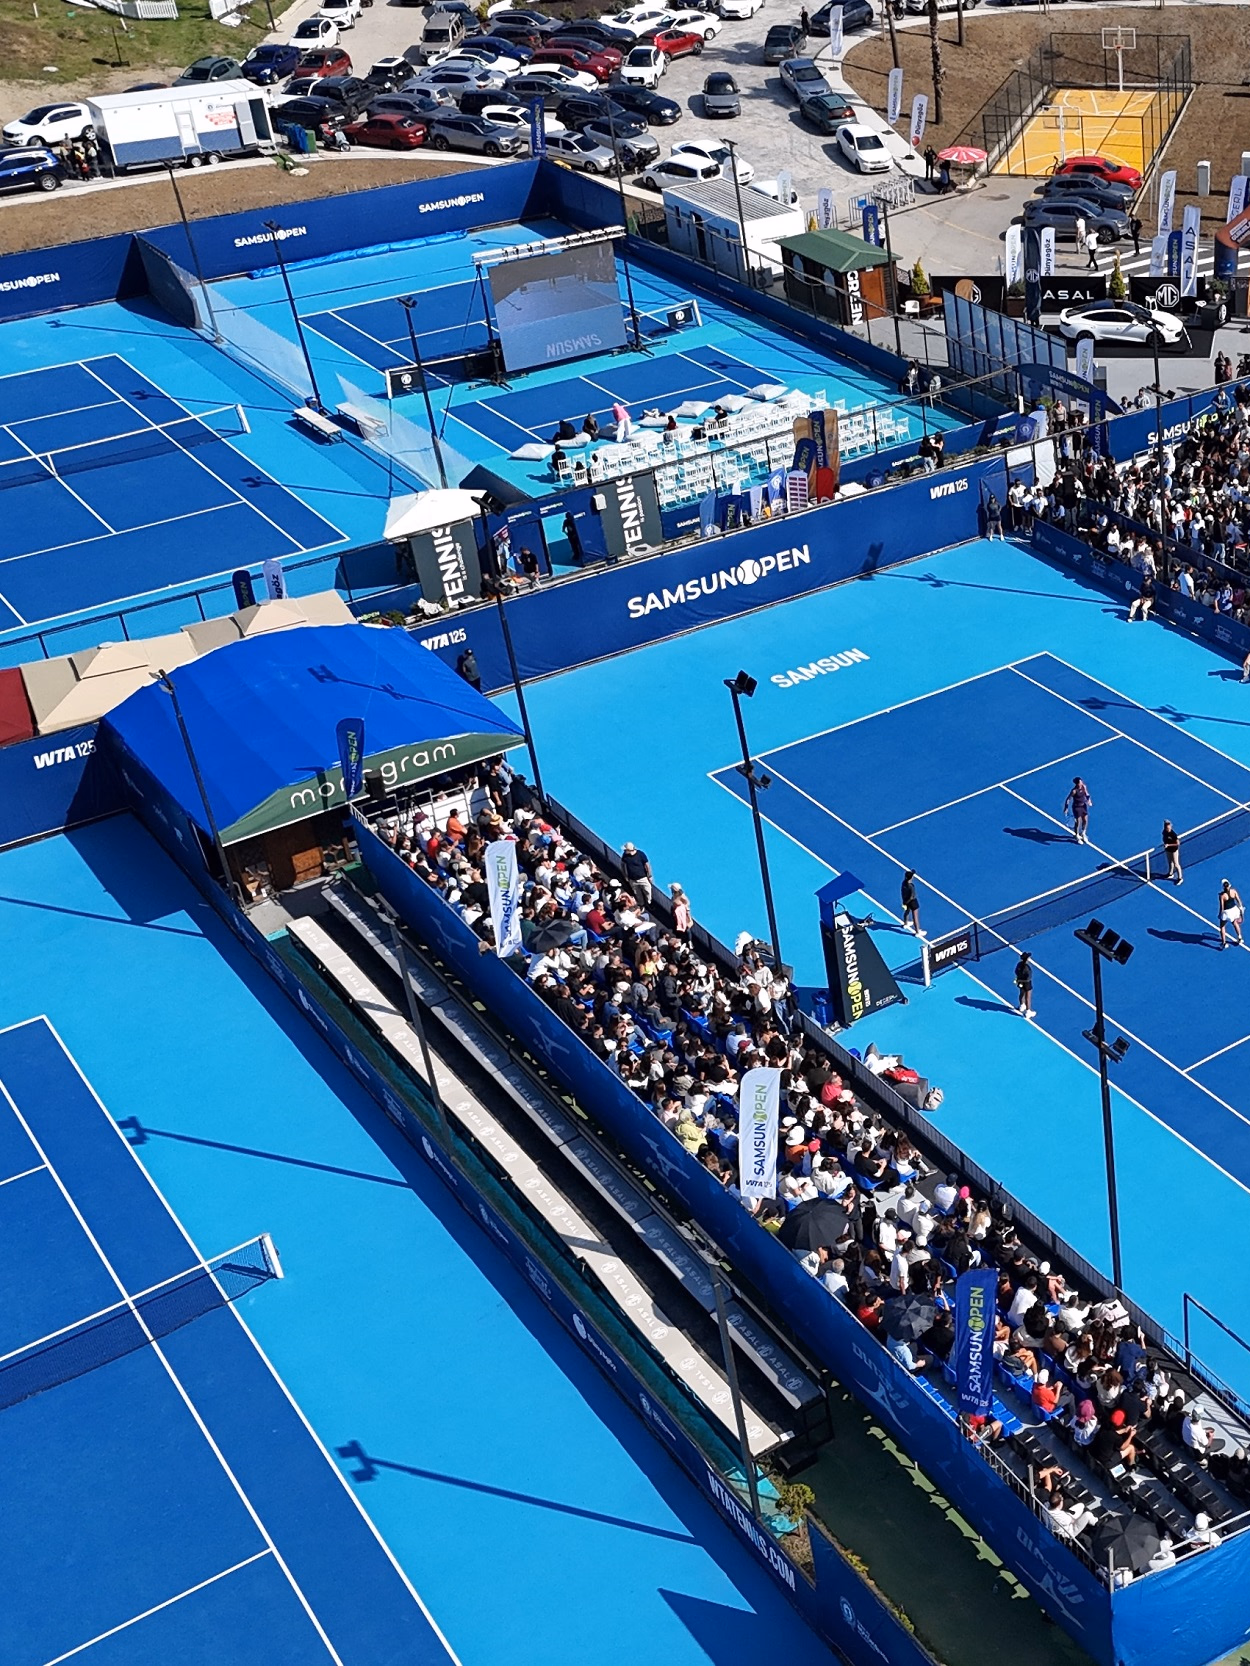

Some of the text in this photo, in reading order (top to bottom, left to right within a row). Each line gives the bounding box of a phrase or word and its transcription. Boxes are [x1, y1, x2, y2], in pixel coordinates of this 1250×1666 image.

[1042, 290, 1095, 300] ASAL
[1157, 286, 1179, 304] MG
[546, 333, 603, 358] SAMSUN
[930, 478, 969, 500] WTA 125
[448, 627, 467, 644] 125
[770, 648, 871, 689] SAMSUN
[34, 739, 97, 770] WTA 125
[935, 939, 968, 963] WTA 125
[467, 1110, 483, 1129] ASAL
[752, 1084, 768, 1177] SAMSUNOPEN
[535, 1188, 552, 1207] ASAL
[561, 1216, 579, 1235] ASAL
[612, 1273, 631, 1295] ASAL
[636, 1306, 656, 1328] ASAL
[738, 1324, 760, 1347] ASAL
[768, 1356, 791, 1380] ASAL
[967, 1286, 986, 1394] SAMSUNOPEN
